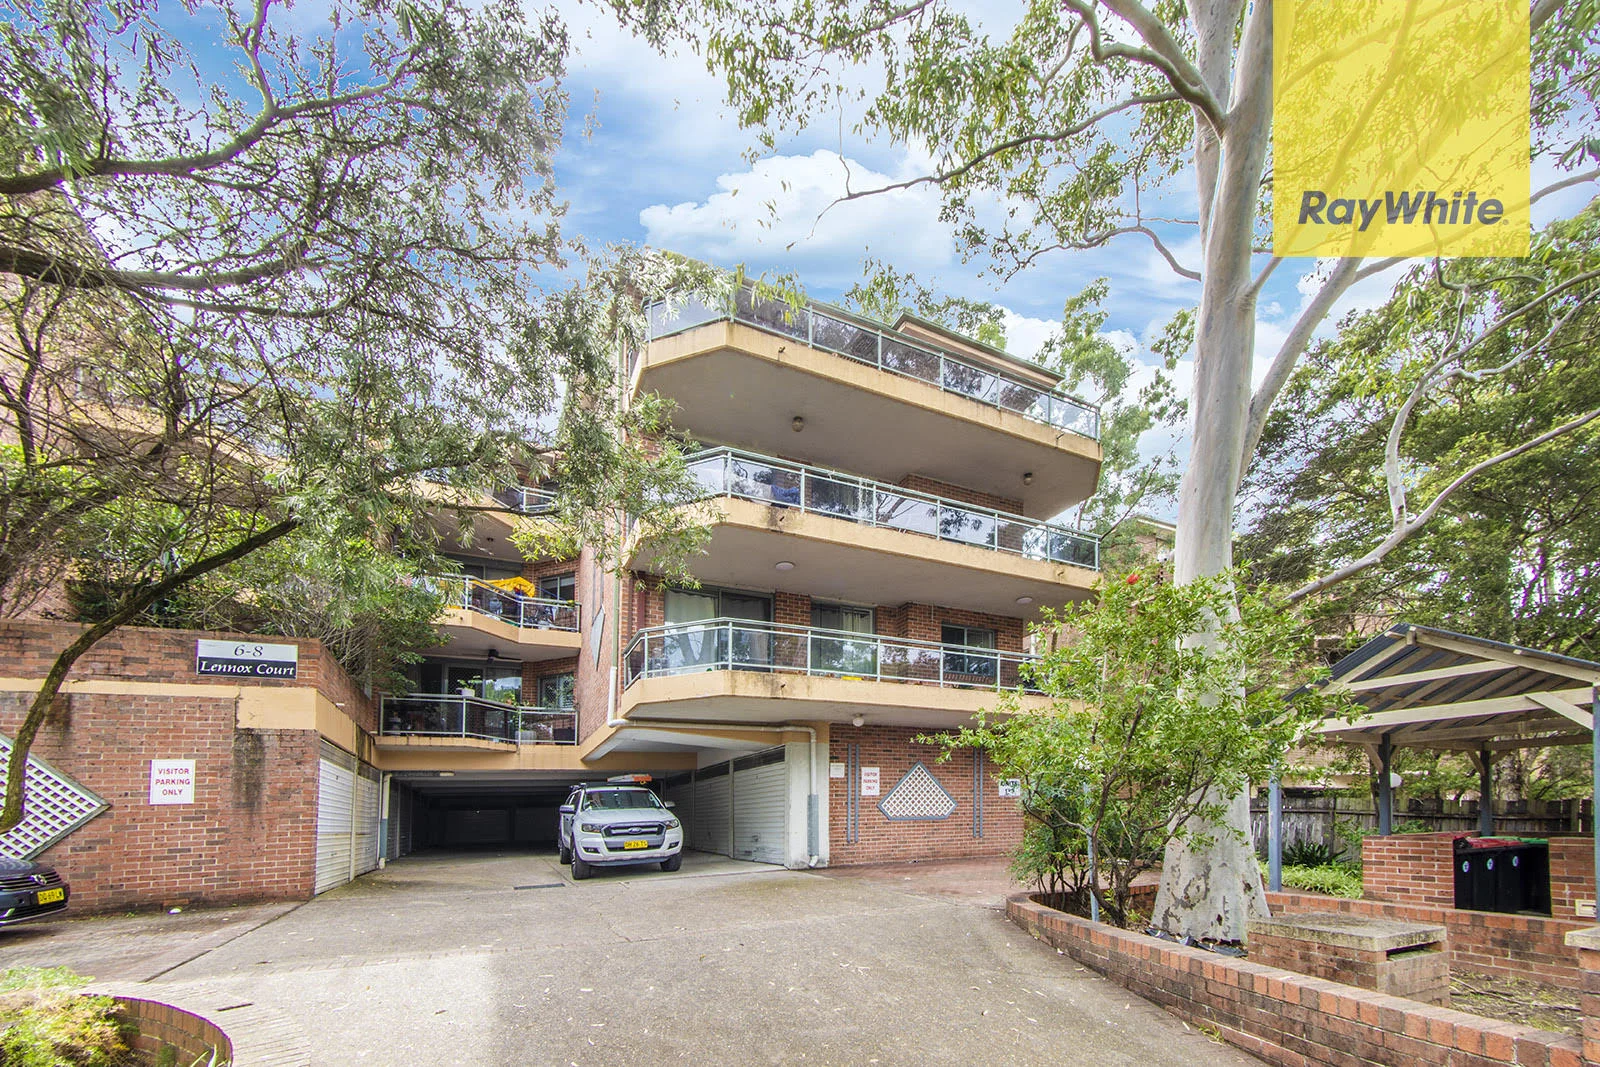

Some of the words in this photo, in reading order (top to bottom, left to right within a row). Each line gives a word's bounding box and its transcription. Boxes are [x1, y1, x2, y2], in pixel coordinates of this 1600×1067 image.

[234, 644, 263, 657] 6-8
[200, 660, 253, 673] Lennox
[256, 663, 295, 675] Court
[162, 788, 183, 796] ONLY
